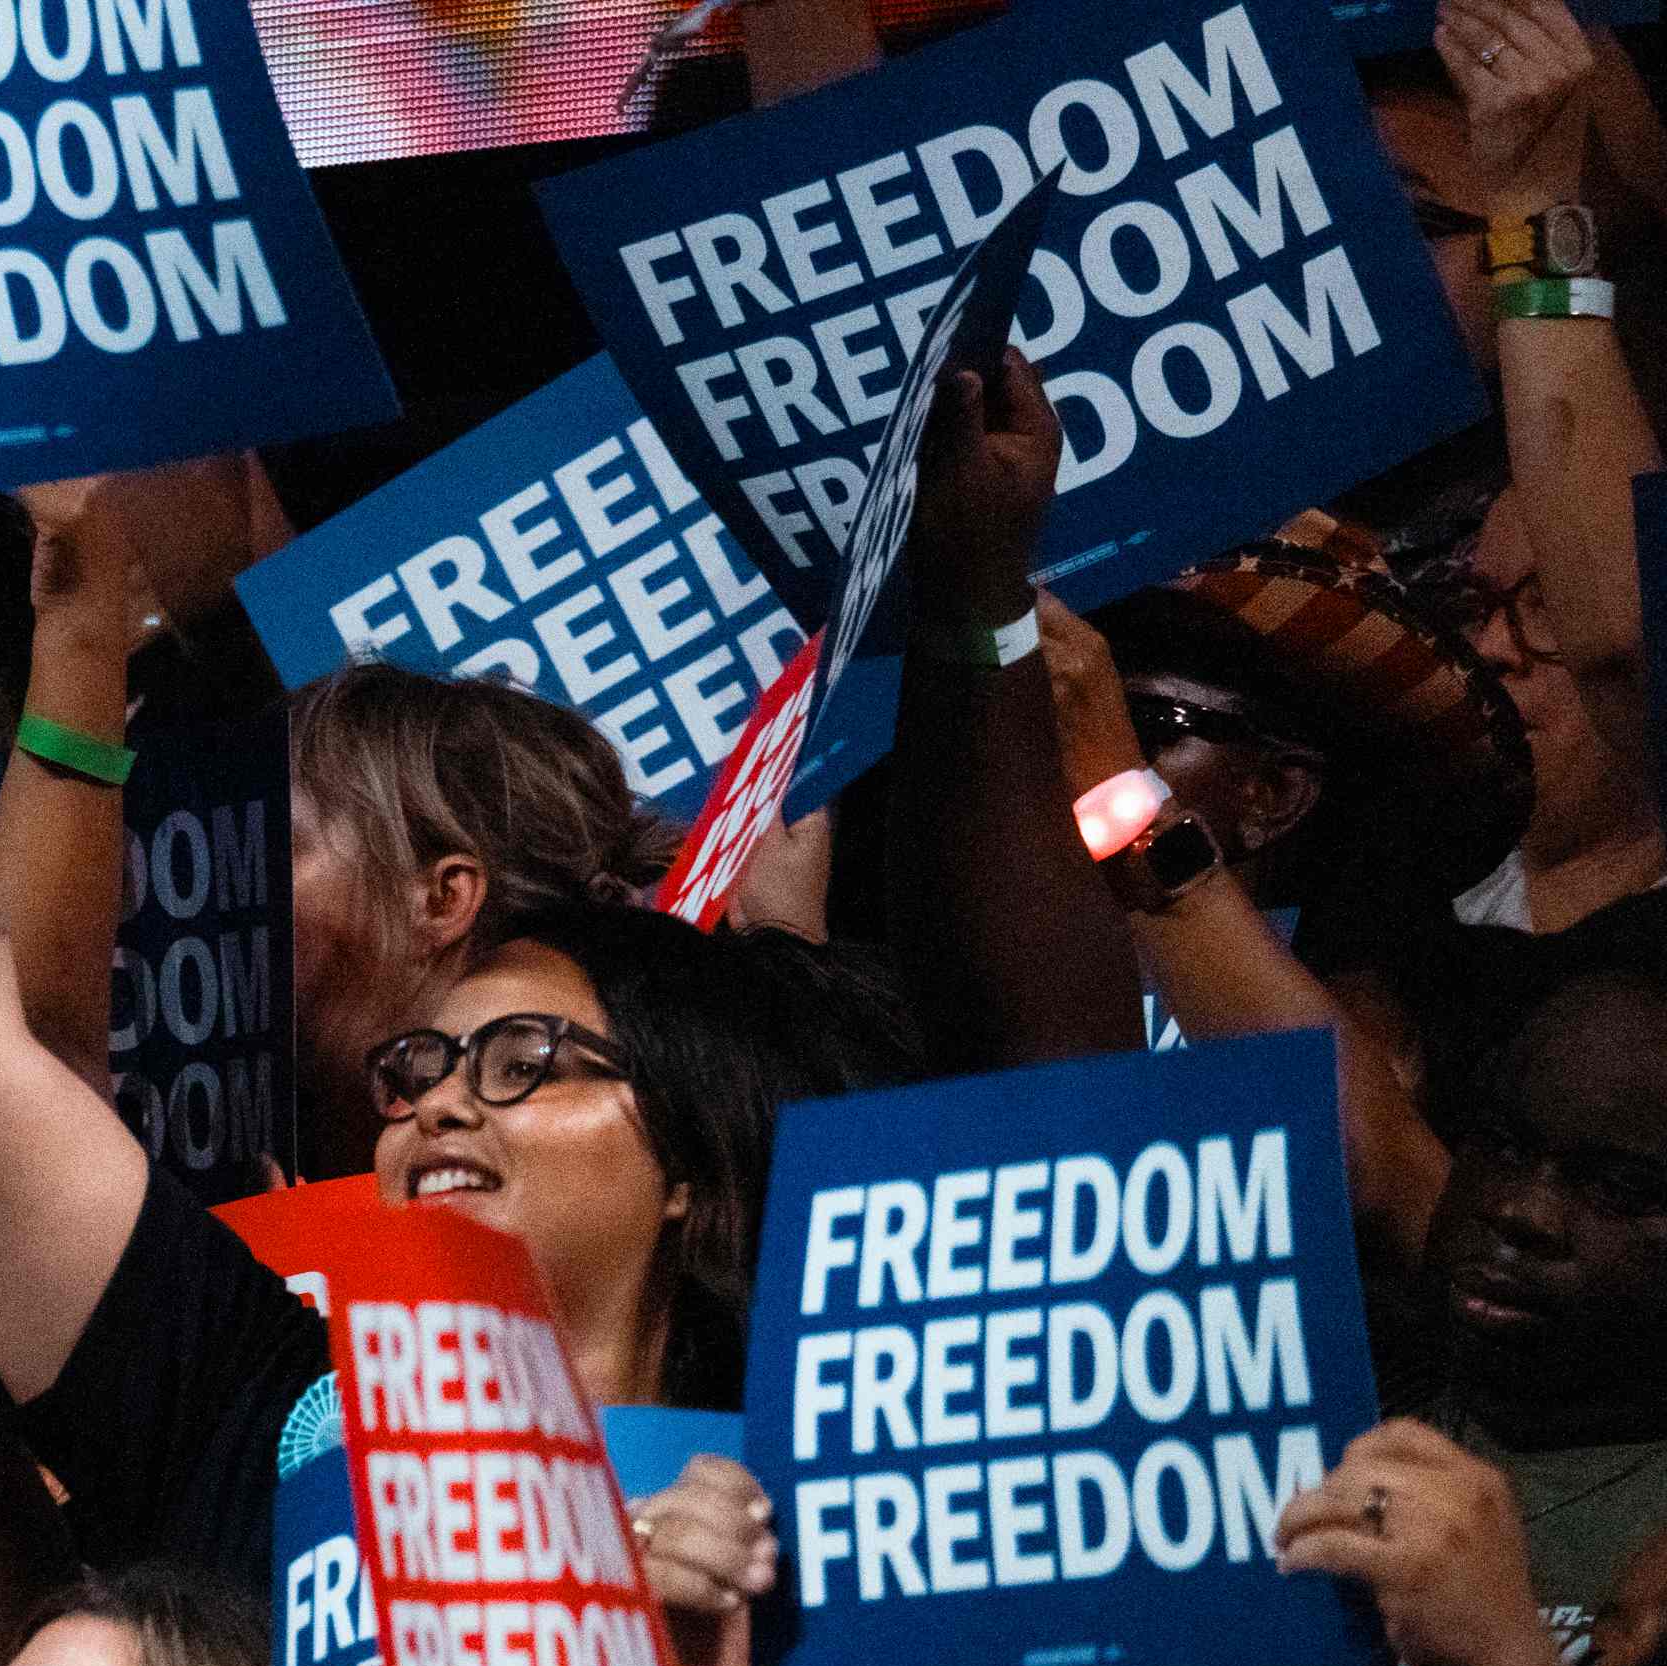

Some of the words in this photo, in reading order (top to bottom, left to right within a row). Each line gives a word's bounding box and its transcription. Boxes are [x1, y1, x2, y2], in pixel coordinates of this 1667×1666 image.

[618, 4, 1282, 348] FREEDOM
[801, 1128, 1293, 1315] FREEDOM
[794, 1277, 1312, 1461] FREEDOM
[795, 1425, 1325, 1609] FREEDOM
